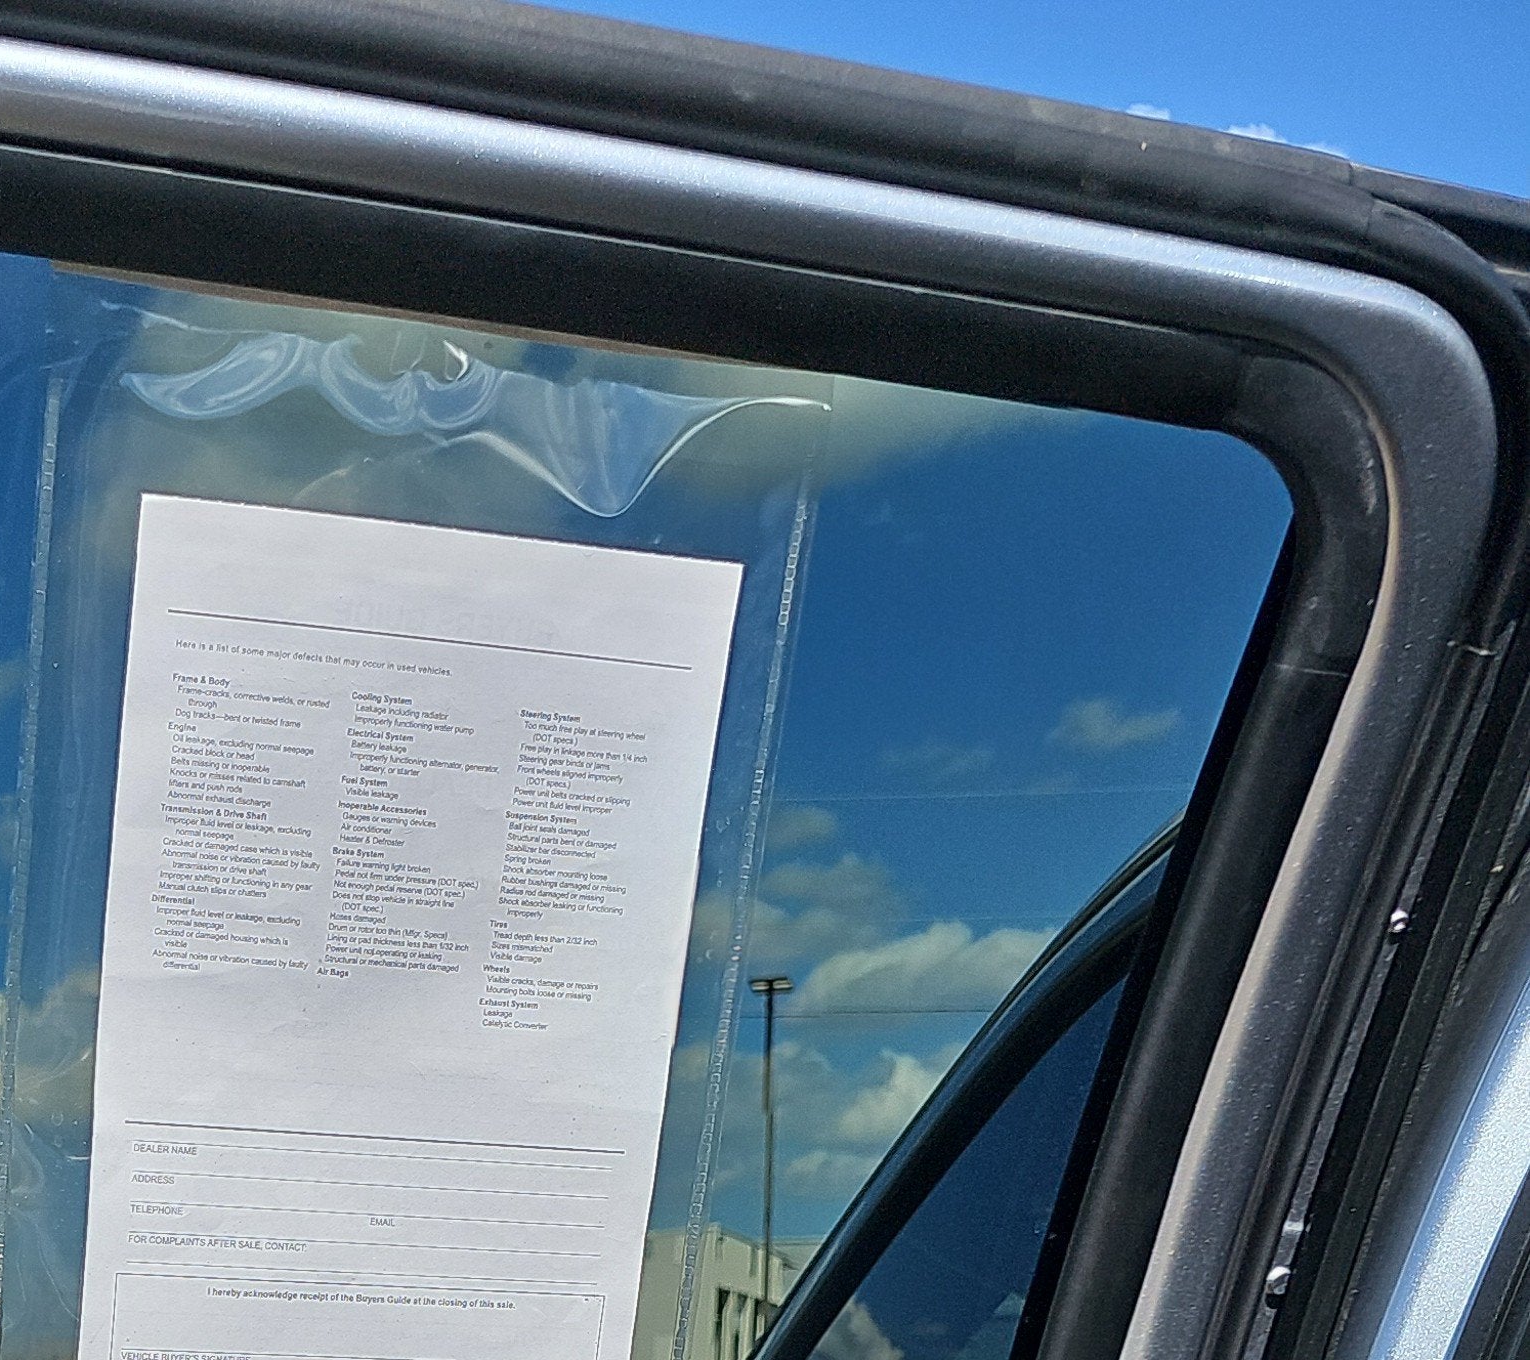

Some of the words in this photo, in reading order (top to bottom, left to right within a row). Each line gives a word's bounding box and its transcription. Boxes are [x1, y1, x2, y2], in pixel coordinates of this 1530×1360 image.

[172, 672, 199, 683] Frame
[207, 675, 231, 689] Body
[519, 708, 552, 722] Steering
[552, 712, 581, 725] System
[167, 720, 197, 735] Engine
[346, 727, 384, 740] Electrical
[384, 731, 414, 745] System
[341, 774, 358, 784] Fuel
[358, 776, 388, 789] System
[337, 799, 380, 814] Inoperable
[379, 803, 427, 816] Accessories
[504, 809, 549, 824] Suspension
[549, 813, 577, 827] System
[503, 853, 527, 866] Spring
[527, 855, 552, 866] broken
[510, 999, 539, 1012] System
[132, 1142, 170, 1153] DEALER
[170, 1145, 197, 1155] NAME
[130, 1173, 175, 1184] ADDRESS
[129, 1203, 184, 1215] TELEPHONE
[369, 1216, 396, 1226] EMAIL
[127, 1234, 147, 1243] FOR
[148, 1235, 206, 1246] COMPLAINTS
[206, 1238, 237, 1247] AFTER
[211, 1287, 242, 1299] hereby
[242, 1288, 298, 1302] acknowledge
[298, 1291, 329, 1303] receipt
[329, 1292, 340, 1301] of
[339, 1293, 354, 1302] the
[354, 1293, 385, 1306] Buyers
[385, 1295, 412, 1305] Guide
[412, 1296, 422, 1305] at
[422, 1296, 436, 1306] the
[436, 1297, 468, 1310] closing
[468, 1299, 478, 1308] of
[478, 1299, 495, 1308] this
[120, 1351, 159, 1360] VEHICLE
